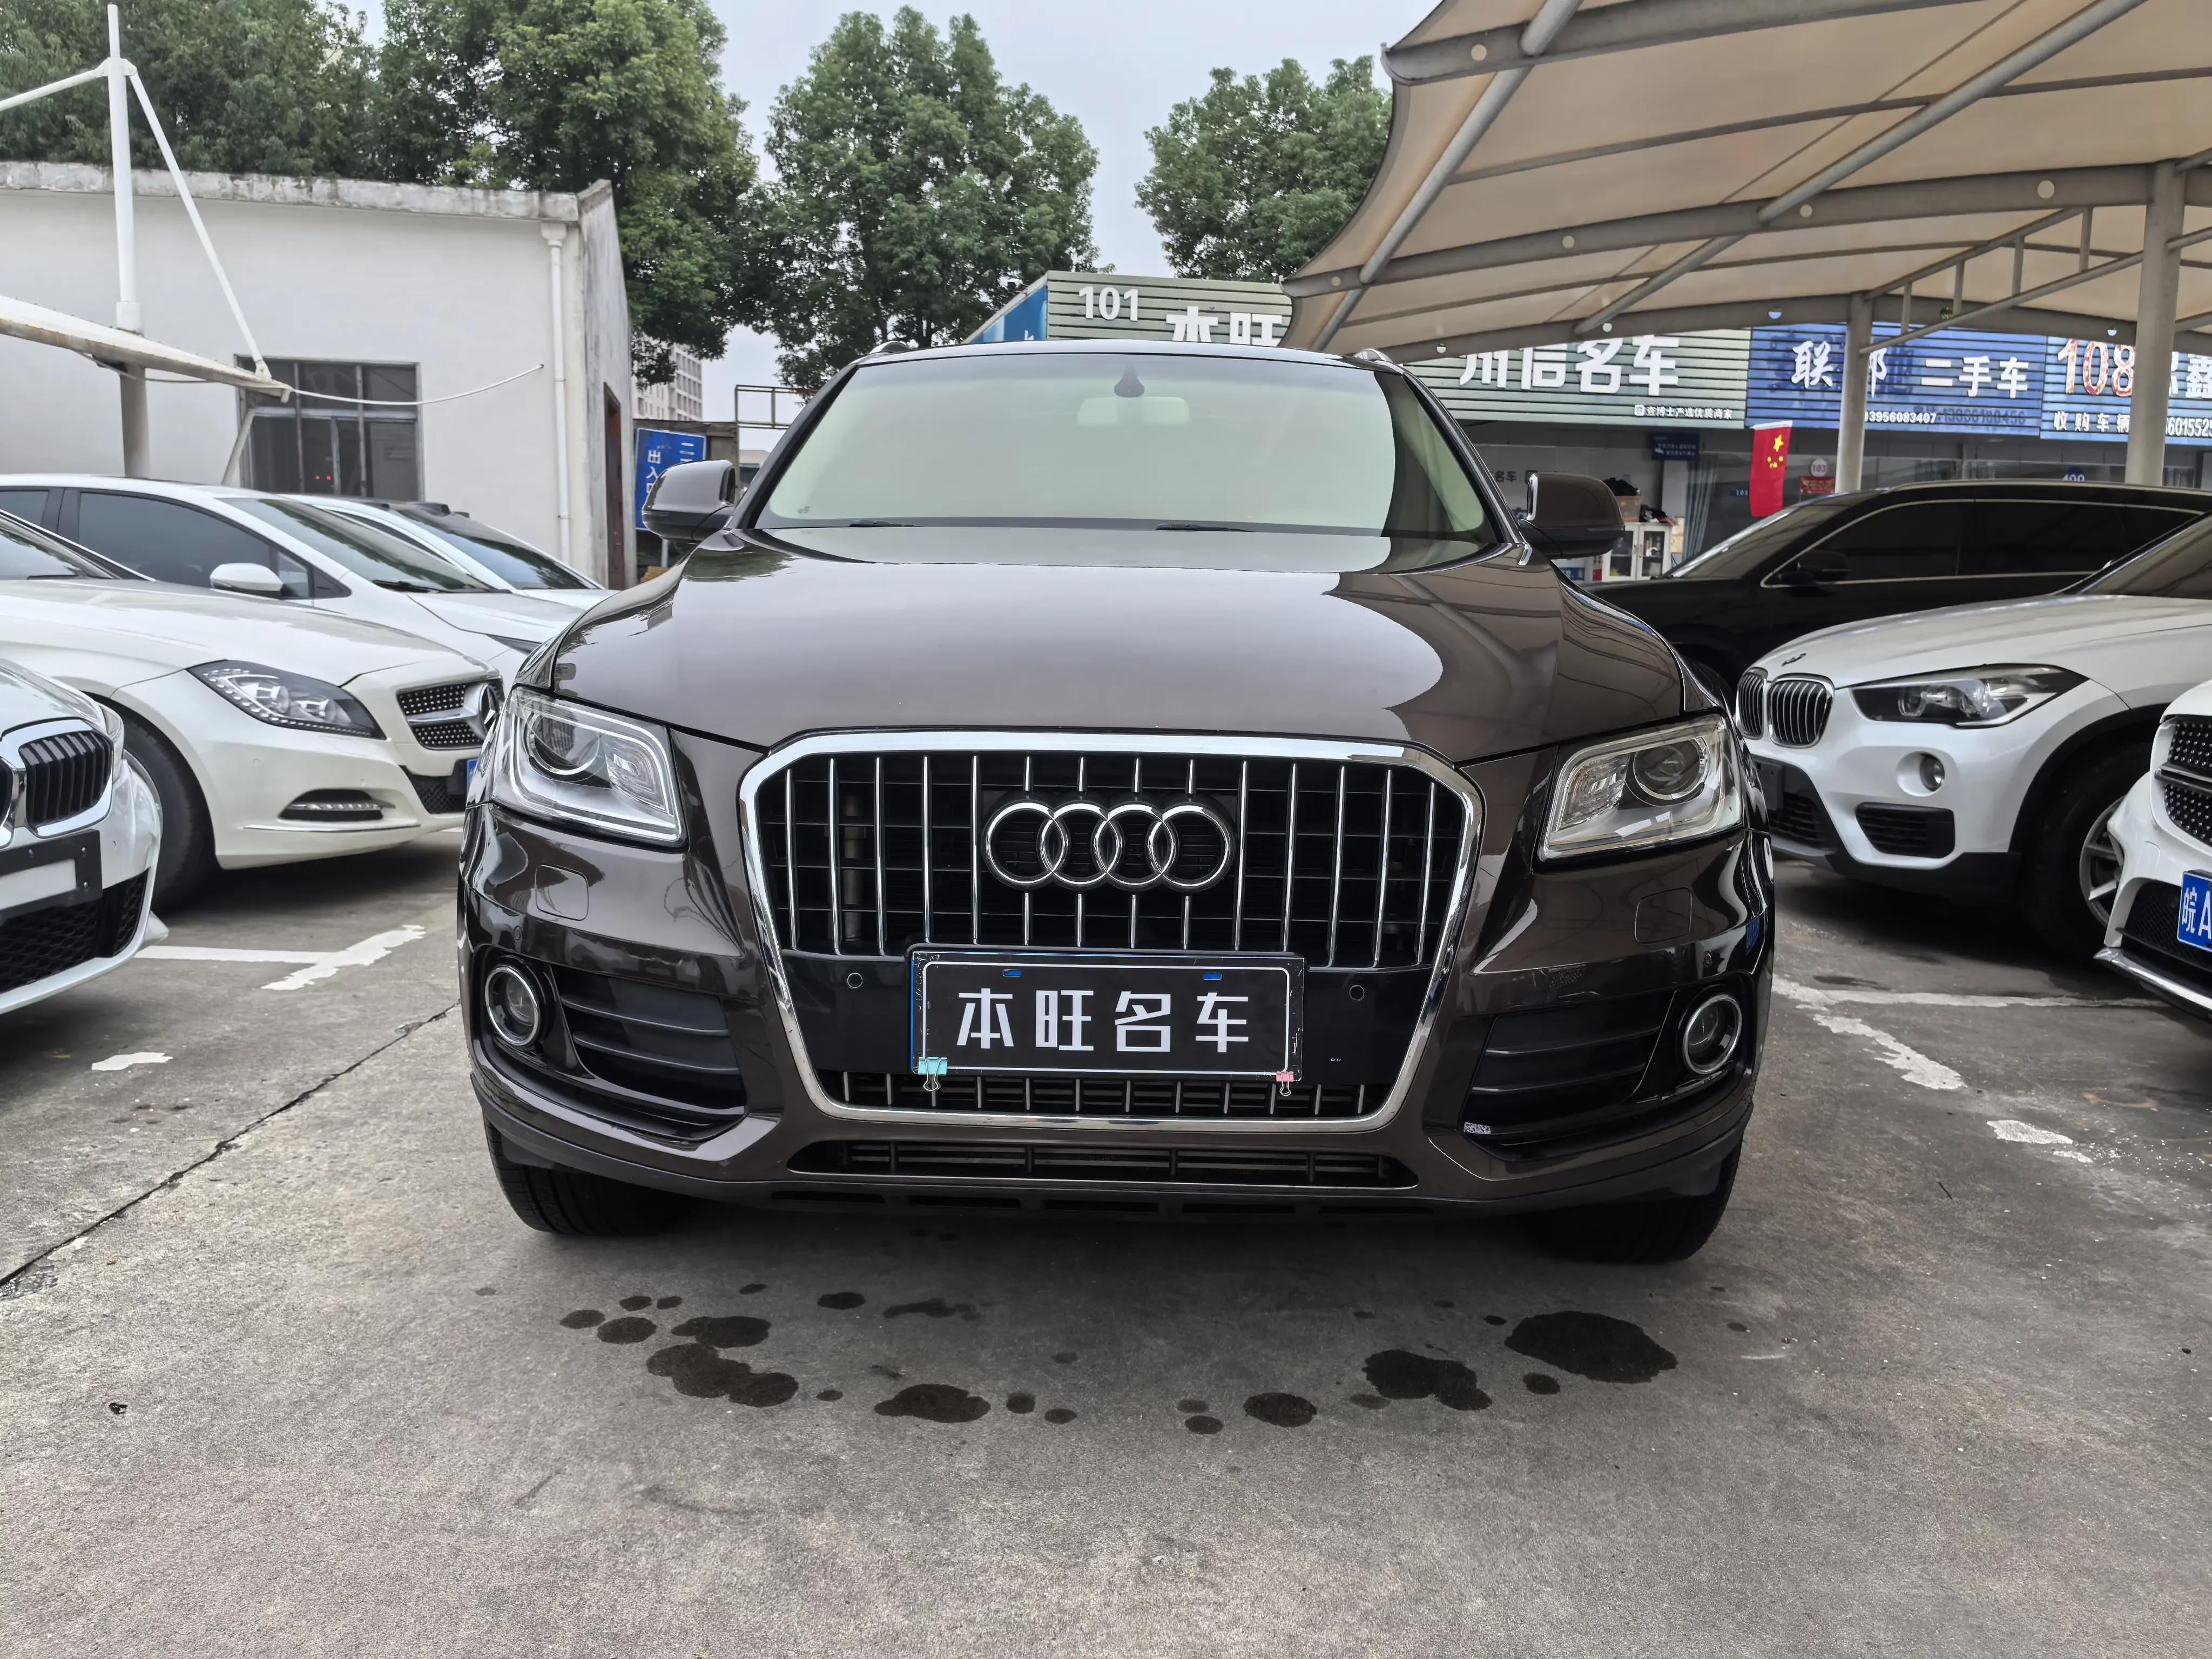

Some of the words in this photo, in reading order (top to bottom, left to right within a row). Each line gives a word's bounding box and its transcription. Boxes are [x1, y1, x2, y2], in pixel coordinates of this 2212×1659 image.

[1078, 287, 1138, 321] 101
[1921, 355, 2029, 399] 二手车
[2058, 339, 2136, 396] 108
[2182, 886, 2212, 940] 皖A
[956, 988, 1250, 1053] 本旺名车
